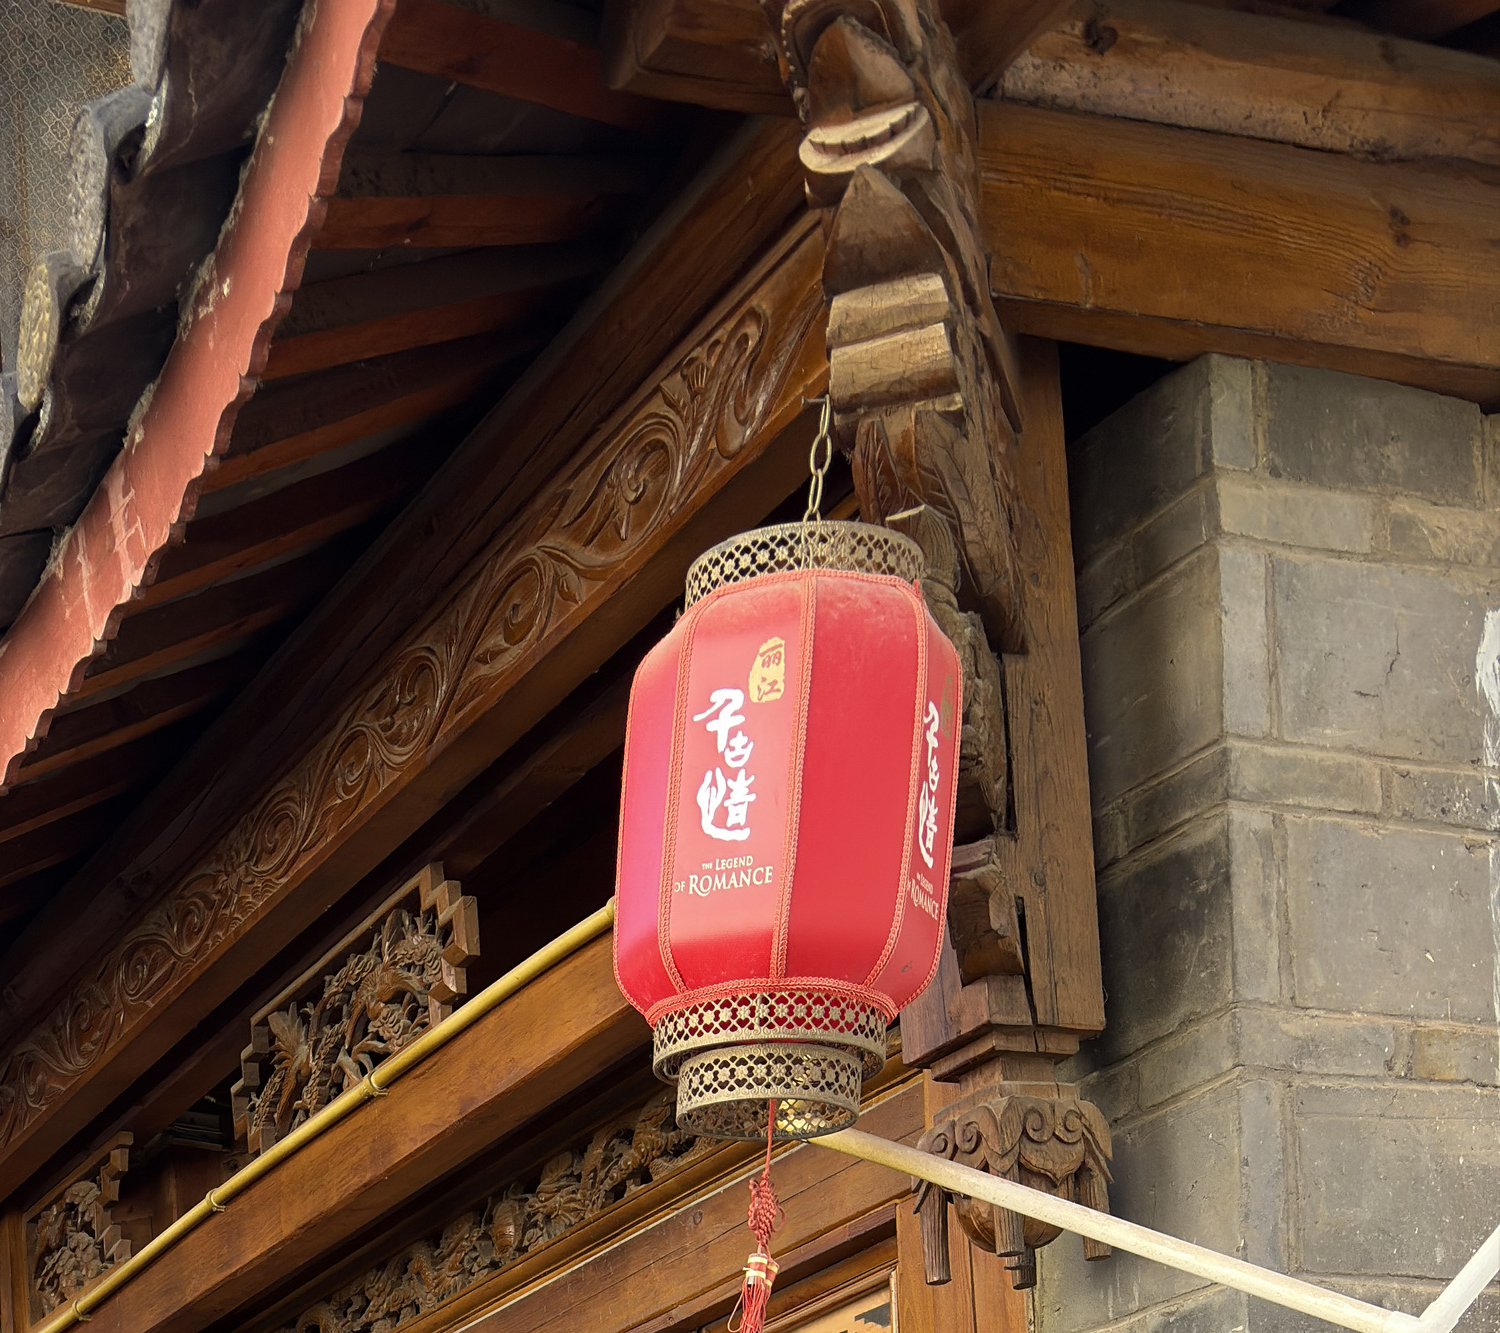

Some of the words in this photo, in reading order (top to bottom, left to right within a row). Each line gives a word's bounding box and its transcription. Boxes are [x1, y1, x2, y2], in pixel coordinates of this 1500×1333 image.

[756, 642, 784, 701] 丽江
[702, 862, 713, 871] THE
[715, 855, 754, 871] LEGEND
[688, 865, 774, 897] ROMANCE
